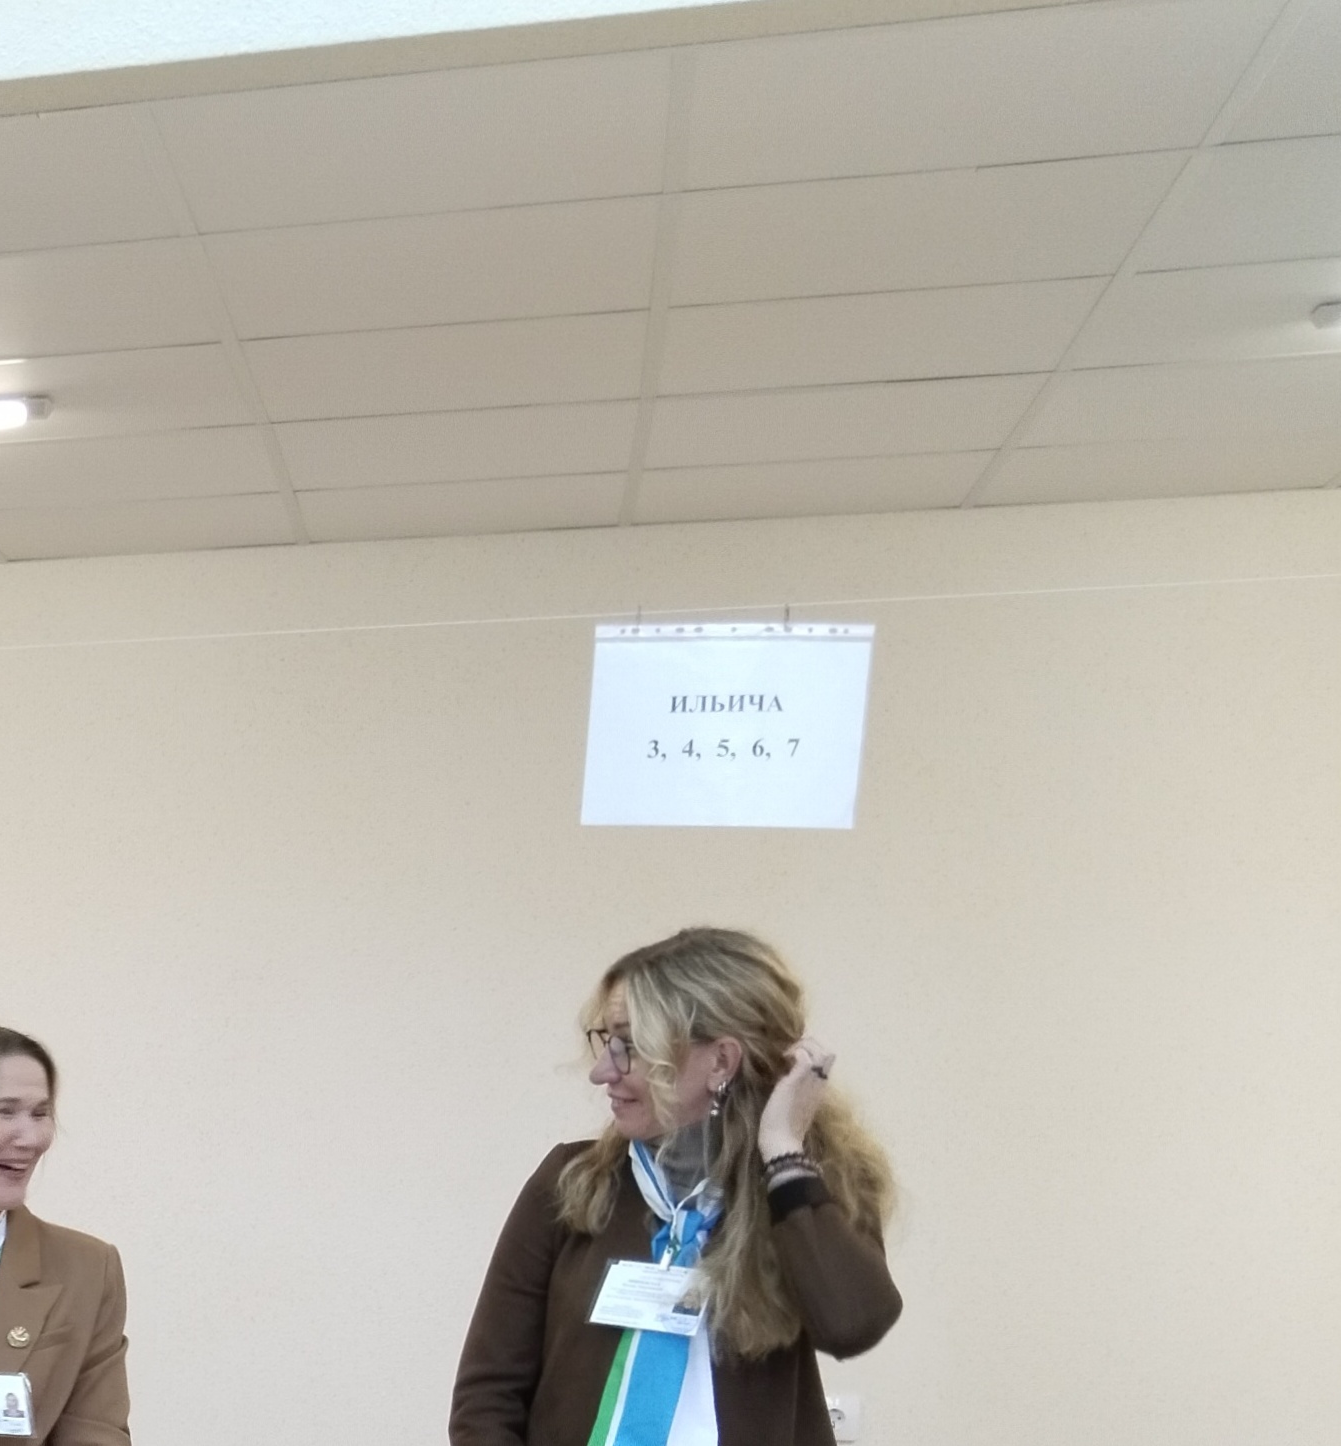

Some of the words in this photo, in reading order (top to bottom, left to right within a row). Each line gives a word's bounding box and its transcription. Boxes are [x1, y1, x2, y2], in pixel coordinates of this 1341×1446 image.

[669, 694, 784, 713] ИЛЬИЧА
[647, 739, 667, 761] 3,
[681, 739, 702, 760] 4,
[716, 739, 737, 760] 5,
[752, 738, 771, 760] 6,
[787, 738, 800, 757] 7
